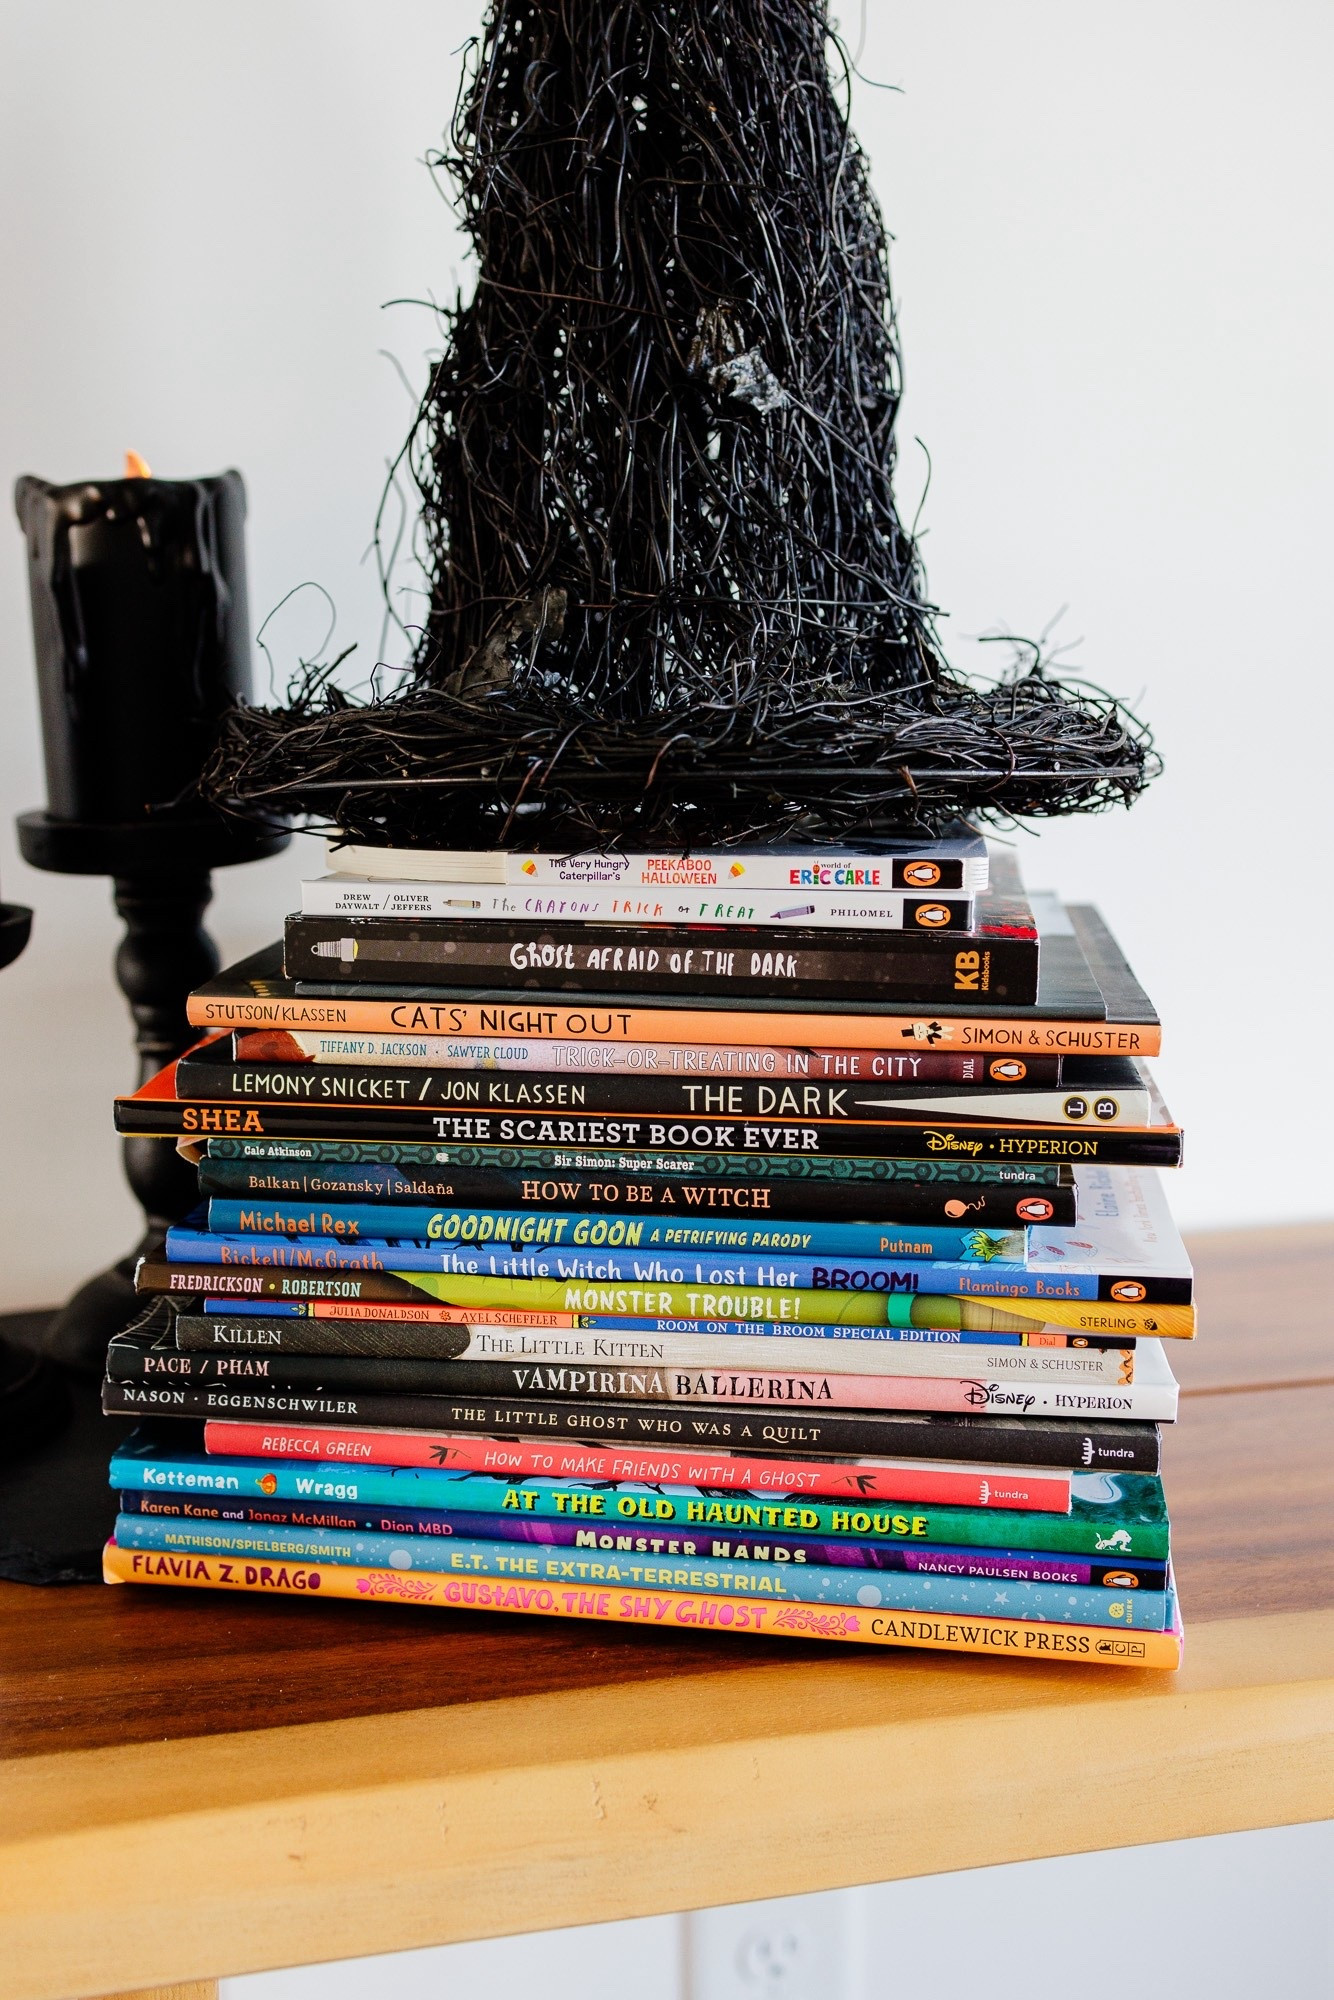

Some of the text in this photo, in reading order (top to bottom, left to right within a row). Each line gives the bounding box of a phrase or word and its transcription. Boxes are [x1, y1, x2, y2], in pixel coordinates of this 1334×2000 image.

[549, 858, 630, 872] The Very Hungry
[647, 859, 712, 871] PEEKABOO
[843, 861, 851, 869] of
[559, 871, 621, 883] Caterpillar's
[641, 872, 717, 884] HALLOWEEN
[834, 869, 881, 886] CARLE
[335, 902, 379, 911] DAYWALT
[343, 893, 371, 902] DREW
[390, 903, 432, 912] JEFFERS
[393, 894, 429, 902] OLIVER
[612, 900, 755, 919] TRICK TREAT
[830, 909, 893, 918] PHILOMEL
[587, 947, 798, 978] AFRAID OF THE DARK
[954, 950, 980, 991] KB
[981, 951, 991, 992] Kidsbooks
[480, 1009, 632, 1035] NIGHT OUT
[320, 1040, 427, 1056] TIFFANY D. JACKSON
[961, 1027, 1140, 1050] SIMON & SCHUSTER
[447, 1045, 529, 1060] SAWYER CLOUD
[552, 1045, 922, 1077] TRICK-OR-TREATING IN THE CITY
[962, 1058, 975, 1080] DIAL
[232, 1073, 586, 1105] LEMONY SNICKET JON KLASSEN
[682, 1085, 849, 1117] THE DARK
[182, 1108, 264, 1133] SHEA
[433, 1117, 819, 1150] THE SCARIEST BOOK EVER
[244, 1146, 312, 1158] Cale Atkinson
[999, 1138, 1099, 1156] HYPERION
[554, 1154, 695, 1171] Sir Simon: Super Scarer
[999, 1170, 1036, 1181] tundra
[521, 1181, 771, 1209] HOW TO BE A WITCH
[240, 1210, 360, 1236] Michael Rex
[427, 1213, 812, 1249] GOODNIGHT GOON A PETRIFYING PARODY
[880, 1237, 933, 1255] Putnam
[440, 1254, 919, 1293] The Little Witch Who Lost Her BROOM!
[170, 1274, 362, 1298] FREDRICKSON ROBERTSON
[959, 1277, 1080, 1296] Flamingo Books
[329, 1305, 430, 1320] JULIA DONALDSON
[564, 1288, 801, 1320] MONSTER TROUBLE!
[460, 1312, 558, 1326] AXEL SCHEFFLER
[1080, 1316, 1137, 1330] STERLING
[657, 1319, 961, 1343] ROOM ON THE BROOM SPECIAL EDITION
[143, 1357, 271, 1377] PACE PHAM
[987, 1357, 1104, 1372] SIMON & SCHUSTER
[512, 1367, 834, 1400] VAMPIRINA BALLERINA
[123, 1388, 358, 1415] NASON EGGENSCHWILER
[1055, 1394, 1133, 1410] HYPERION
[451, 1408, 821, 1444] THE LITTLE GHOST WHO WAS A QUILT
[262, 1437, 372, 1458] REBECCA GREEN
[1098, 1447, 1135, 1459] tundra
[484, 1451, 821, 1488] HOW TO MAKE FRIENDS WITH A GHOST
[143, 1467, 358, 1500] Ketteman Wragg
[994, 1489, 1029, 1500] tundra
[140, 1500, 357, 1528] Karen Kane and Jonaz McMillan
[501, 1489, 929, 1537] AT THE OLD HAUNTED HOUSE
[381, 1519, 453, 1536] Dion MBD
[132, 1555, 321, 1590] FLAVIA Z. DRAGO
[451, 1553, 787, 1593] E.T. THE EXTRA-TERRESTRIAL
[918, 1562, 1078, 1583] NANCY PAULSEN BOOKS
[562, 1592, 768, 1629] THE SHY GHOST
[1126, 1598, 1134, 1624] QUIRK
[871, 1618, 1090, 1654] CANDLEWICK PRESS
